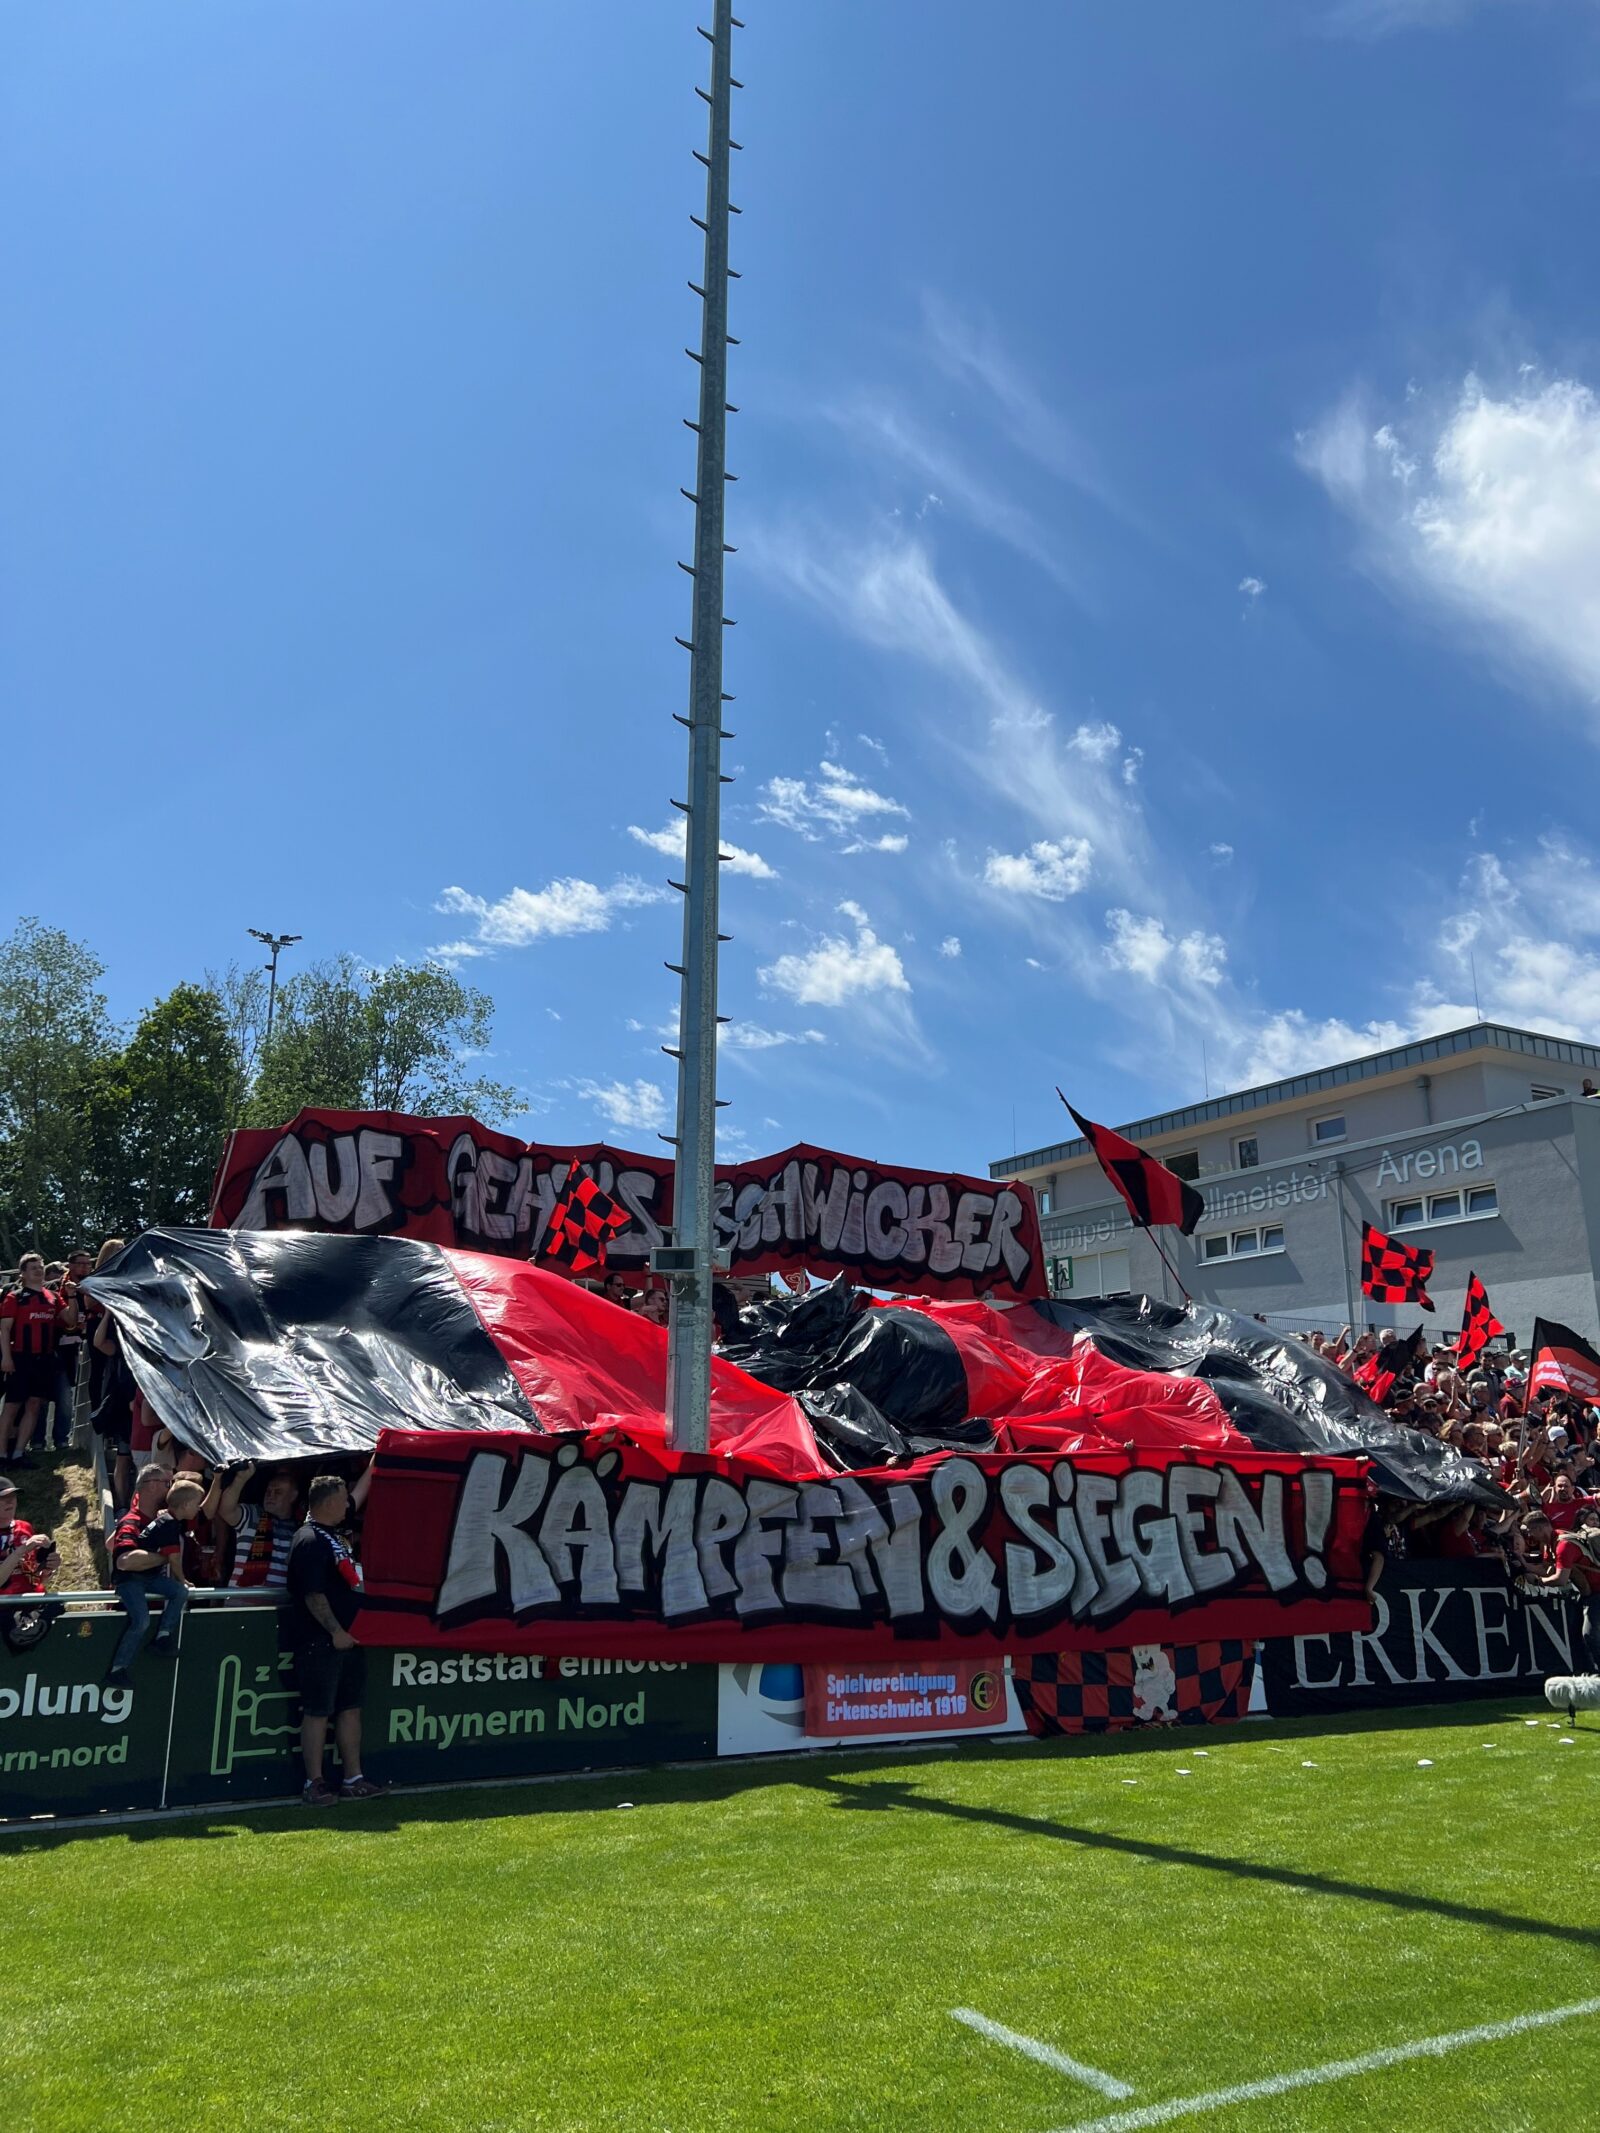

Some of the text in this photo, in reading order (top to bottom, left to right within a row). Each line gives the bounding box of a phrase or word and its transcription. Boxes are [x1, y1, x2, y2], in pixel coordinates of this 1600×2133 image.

[230, 1128, 402, 1230] AUF
[1376, 1140, 1484, 1188] Arena
[437, 1444, 924, 1618] KÄMPFEN
[928, 1458, 1000, 1623] &
[827, 1672, 956, 1698] Spielvereinigung
[827, 1697, 932, 1722] Erkenschwick
[388, 1691, 646, 1750] Rhynern Nord
